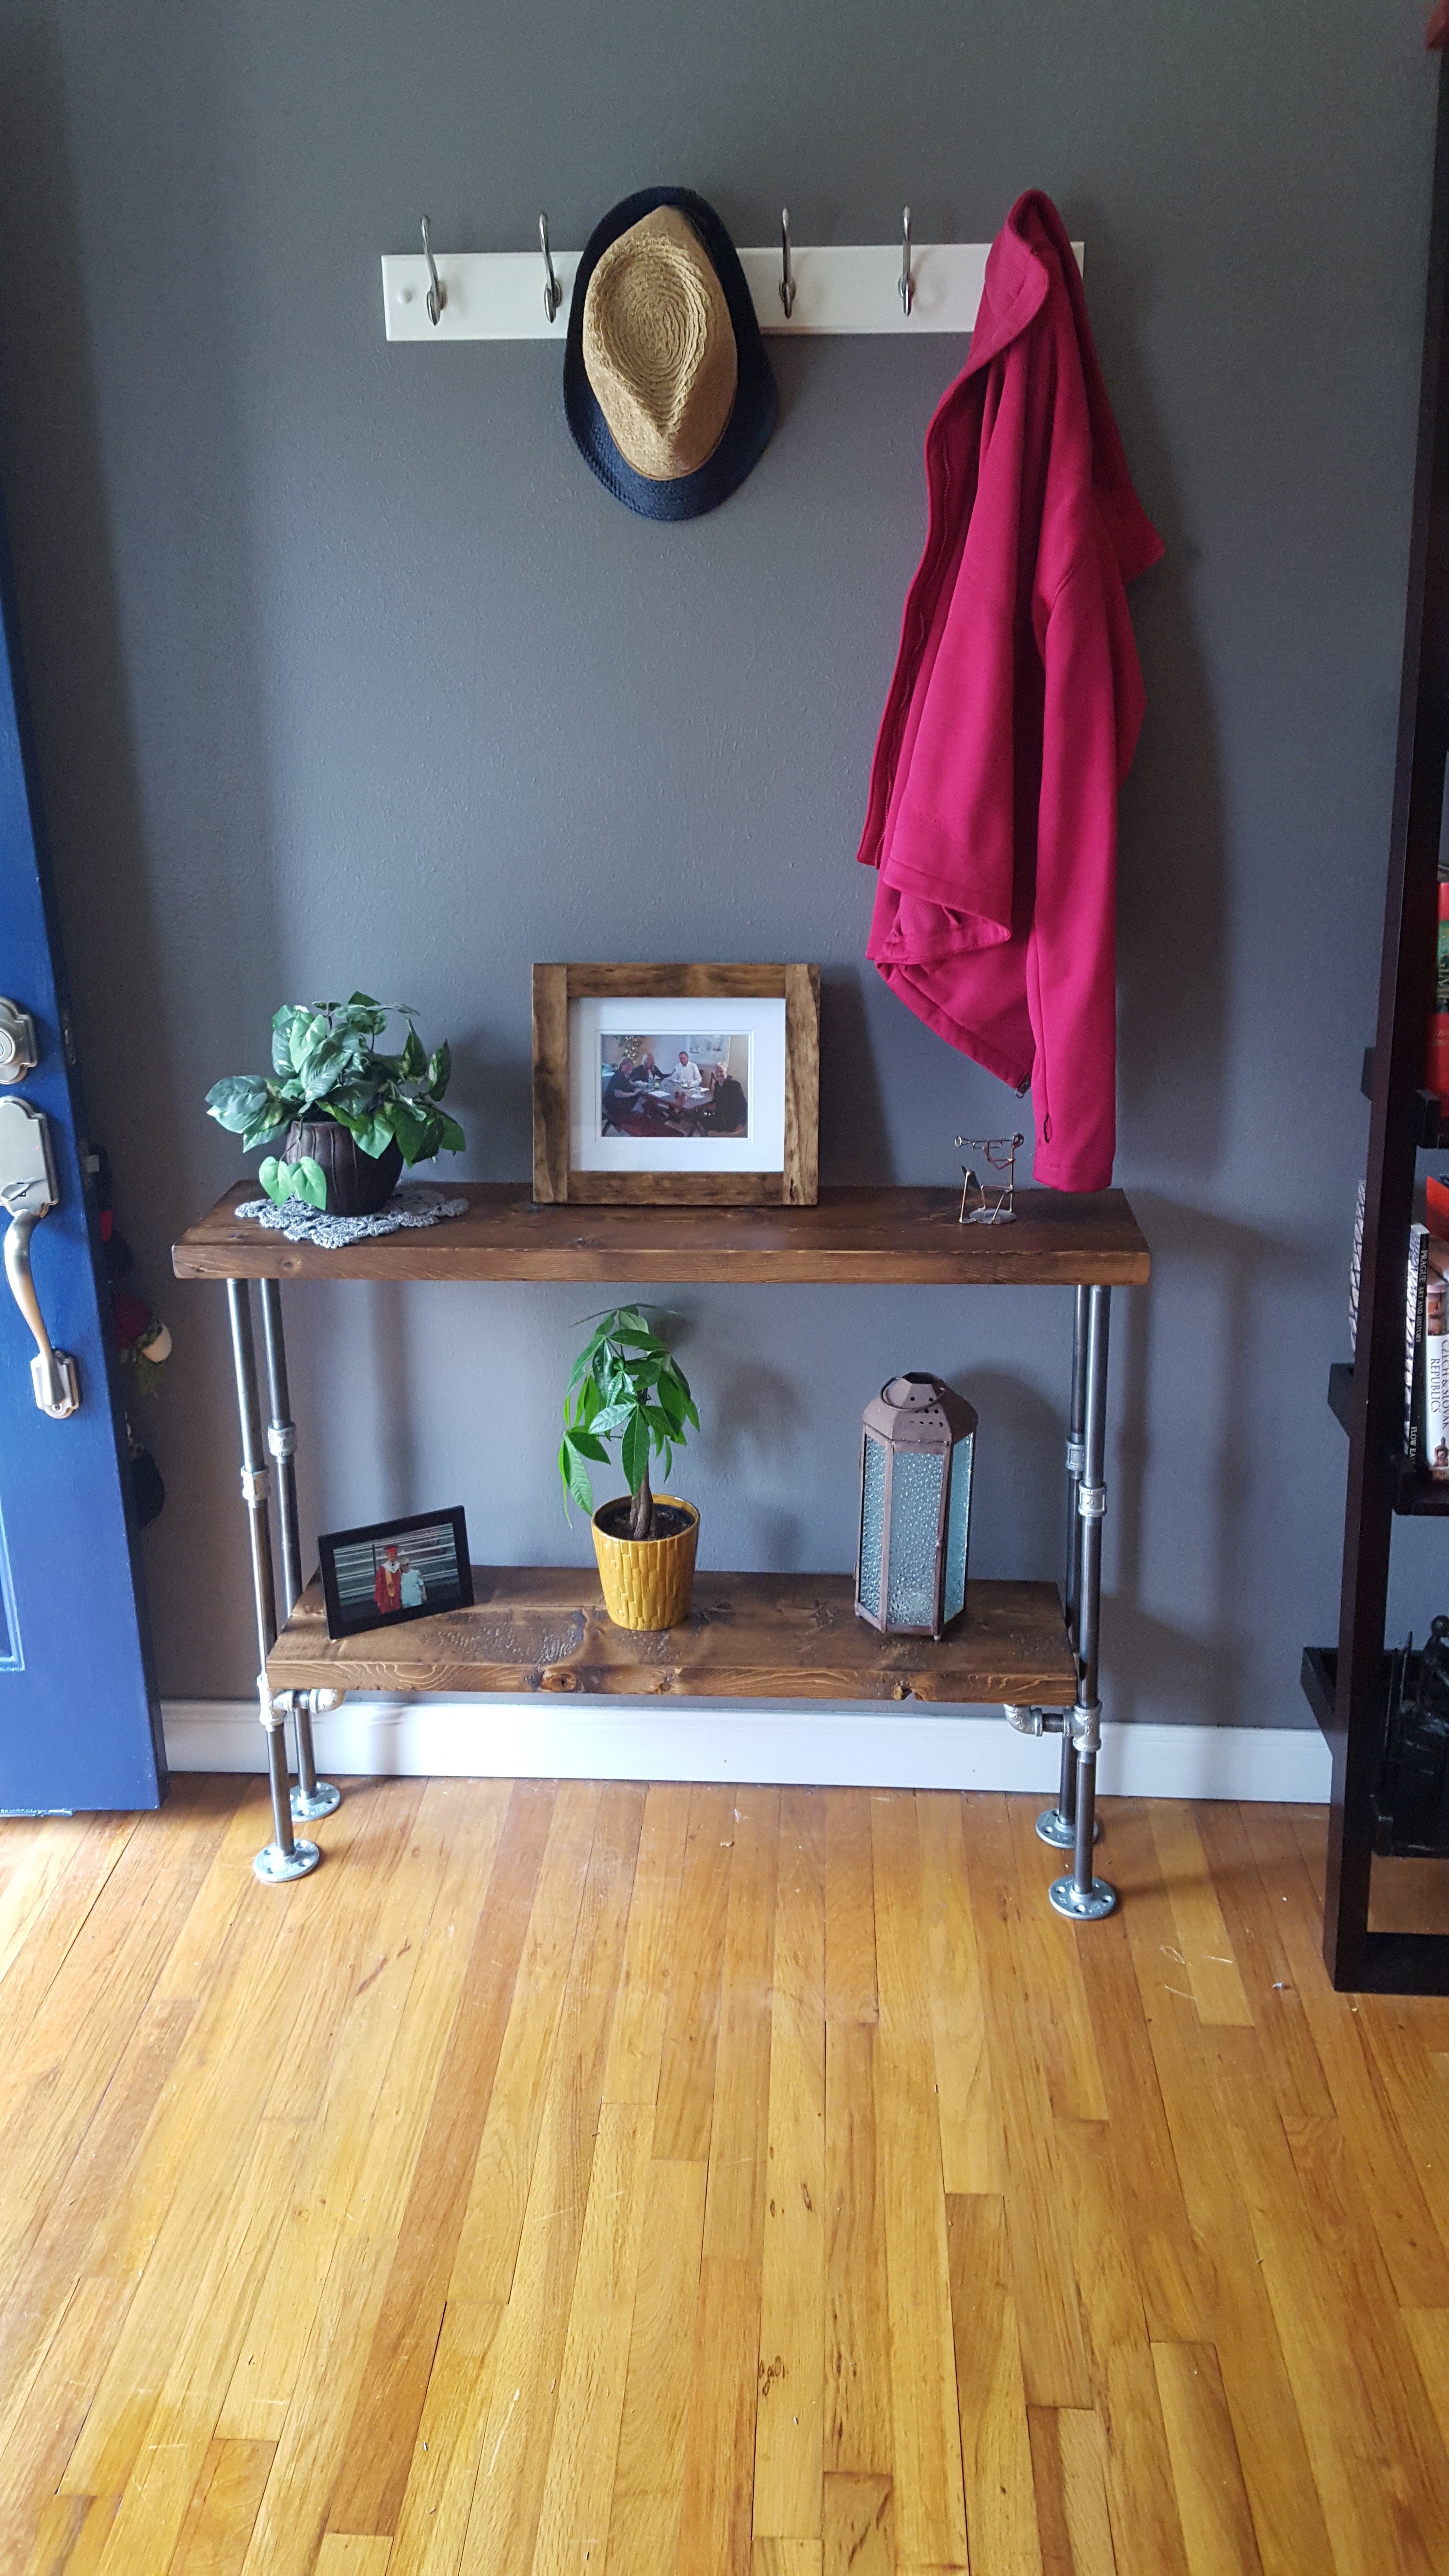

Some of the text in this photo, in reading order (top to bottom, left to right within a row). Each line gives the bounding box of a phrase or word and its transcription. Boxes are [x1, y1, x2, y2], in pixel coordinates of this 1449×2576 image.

[1419, 1250, 1428, 1283] PRAGUE
[1431, 1358, 1441, 1413] REPUBLICS
[1442, 1379, 1449, 1387] &
